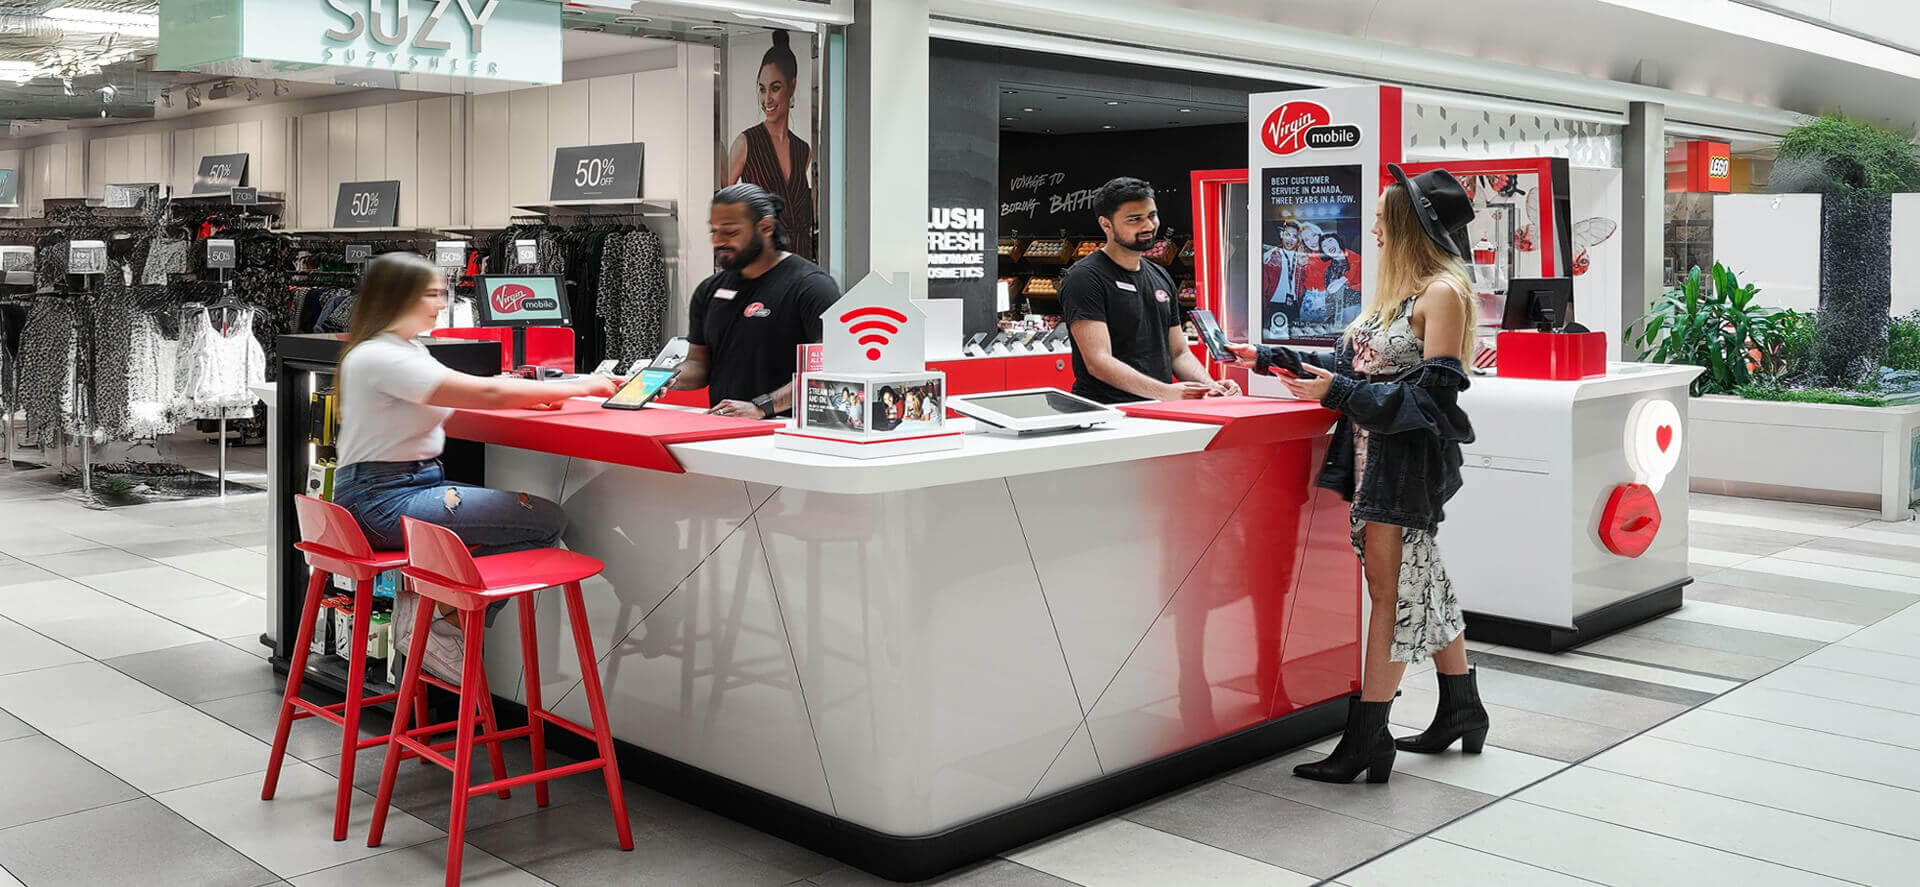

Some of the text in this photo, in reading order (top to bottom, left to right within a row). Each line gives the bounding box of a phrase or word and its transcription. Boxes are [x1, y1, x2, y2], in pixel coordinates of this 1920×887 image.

[326, 0, 500, 53] SUZY
[323, 48, 498, 74] SUZYSHIER
[1268, 105, 1354, 149] Virgin mobile
[207, 163, 232, 184] 50%
[575, 157, 615, 187] 50% OFF
[1710, 157, 1729, 178] LEGO
[1010, 172, 1066, 194] VOYAGE TO
[1271, 176, 1330, 185] BEST CUSTOMER
[1271, 185, 1343, 195] SERVICE IN CANADA,
[351, 192, 379, 216] 50% OFF
[1000, 198, 1040, 219] BORING
[1271, 195, 1356, 205] THREE YEARS IN A ROW.
[928, 207, 985, 230] USH
[928, 231, 985, 251] RESH
[928, 253, 984, 265] ANDMADE
[928, 266, 985, 279] OSMETICS
[495, 285, 553, 311] Virgin mobile
